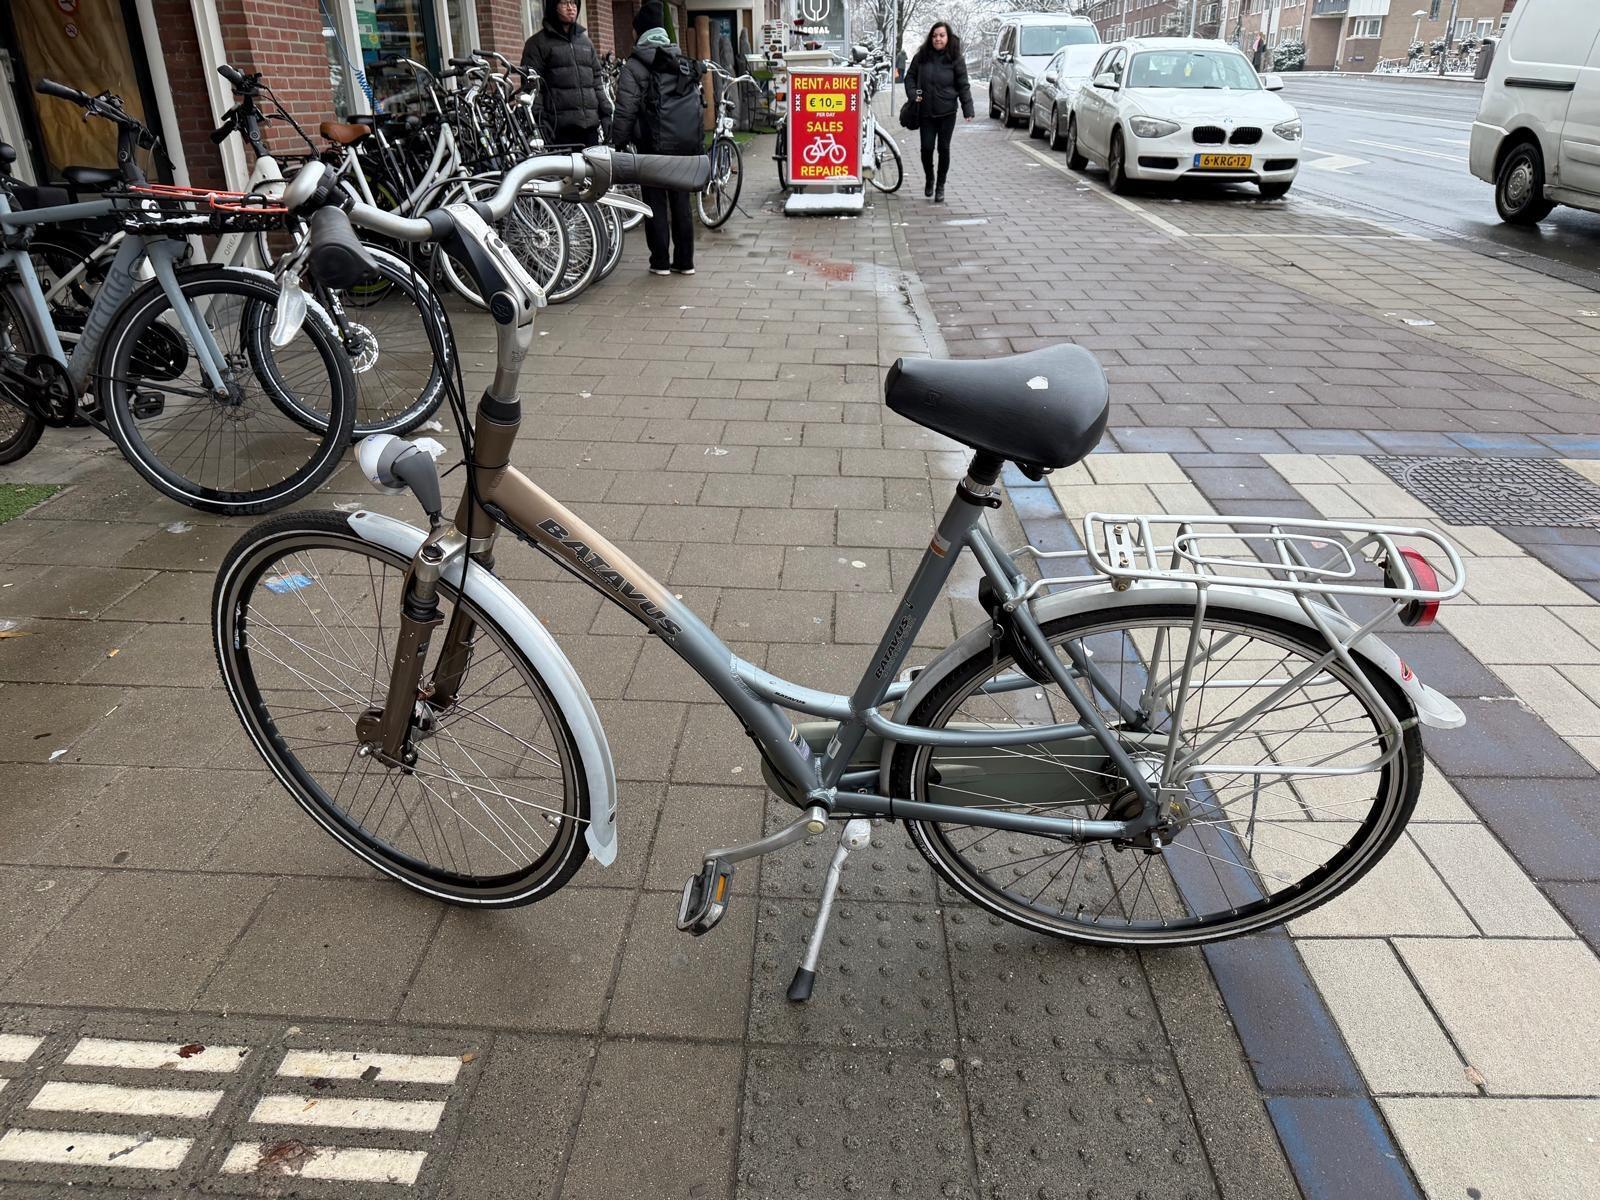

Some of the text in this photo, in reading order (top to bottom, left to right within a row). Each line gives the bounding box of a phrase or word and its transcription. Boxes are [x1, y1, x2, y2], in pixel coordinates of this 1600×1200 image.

[794, 77, 858, 90] RENT A BIKE
[809, 97, 816, 108] €
[806, 121, 844, 132] SALES
[800, 165, 849, 177] REPAIRS
[536, 517, 683, 637] BATAVUS
[874, 616, 910, 681] BATAVUS
